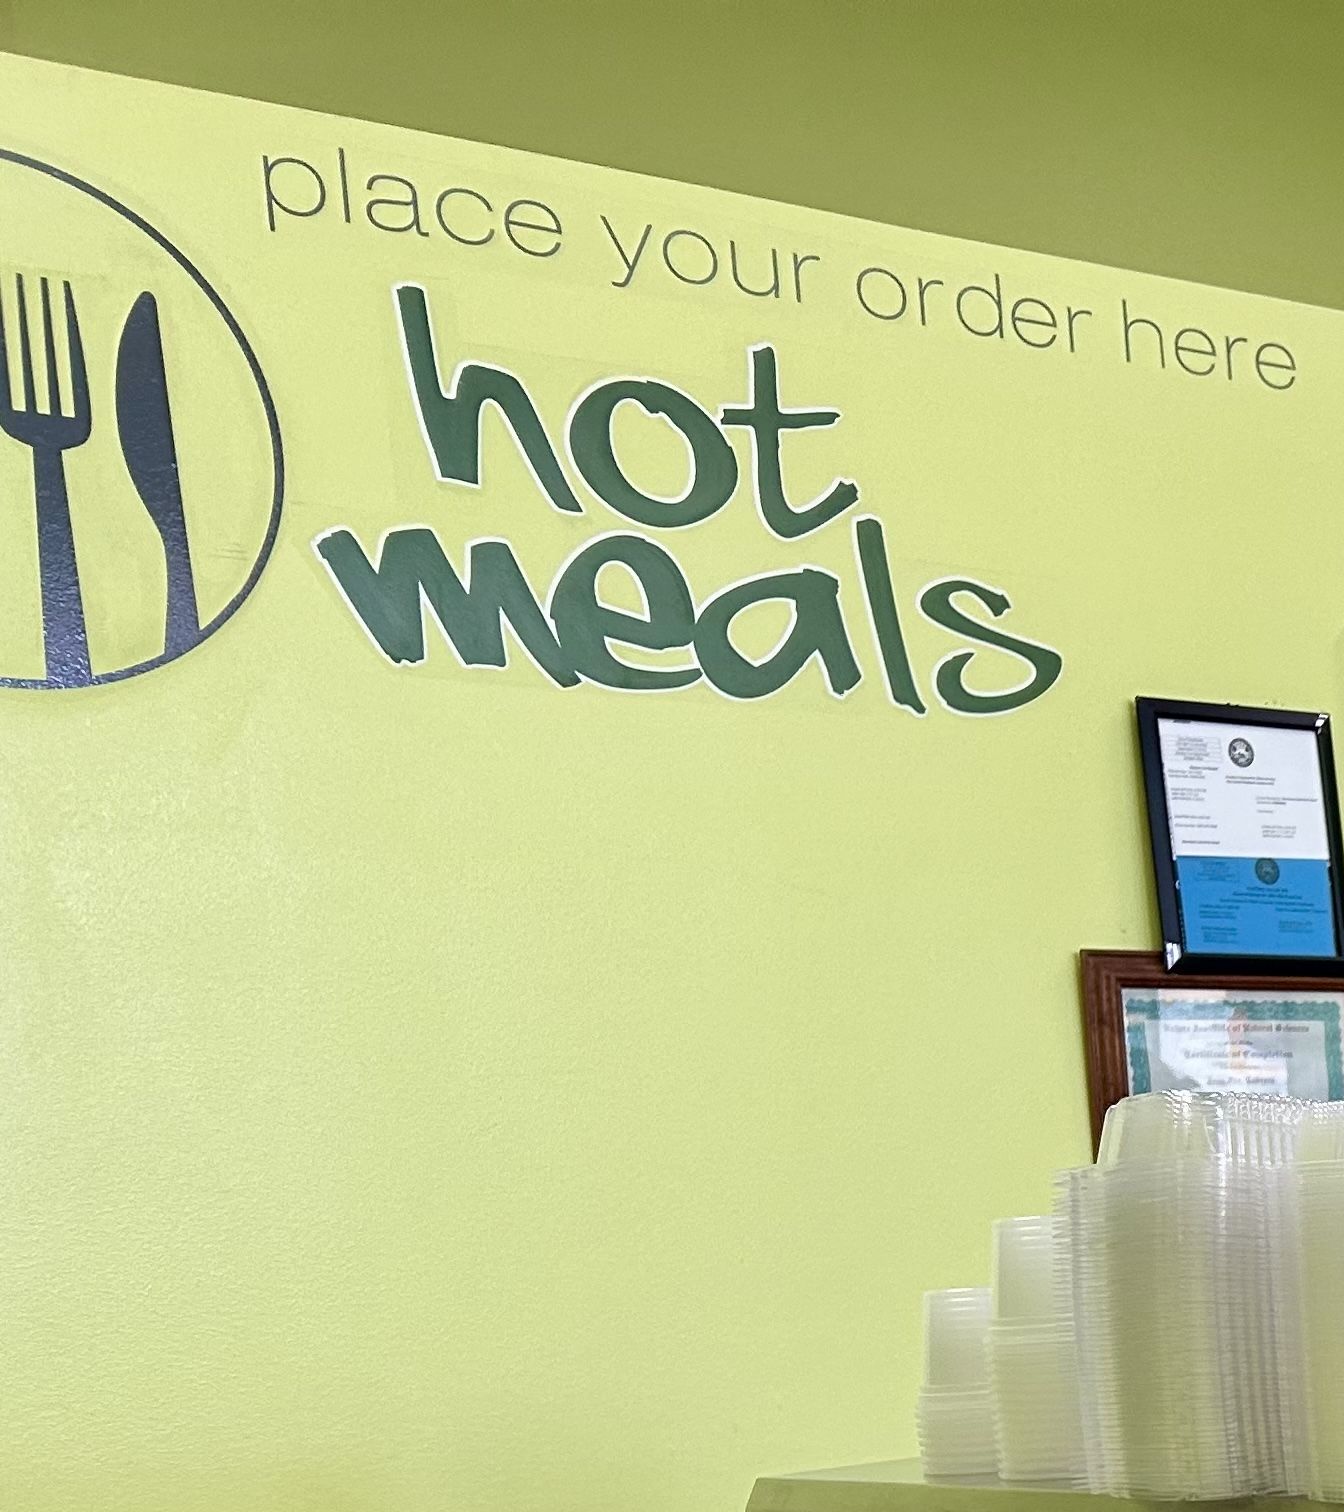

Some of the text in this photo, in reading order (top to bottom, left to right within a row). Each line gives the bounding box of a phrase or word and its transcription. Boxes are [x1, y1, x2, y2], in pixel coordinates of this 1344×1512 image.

[262, 146, 1298, 391] place your order here
[395, 284, 860, 540] hot
[315, 517, 1064, 716] meals
